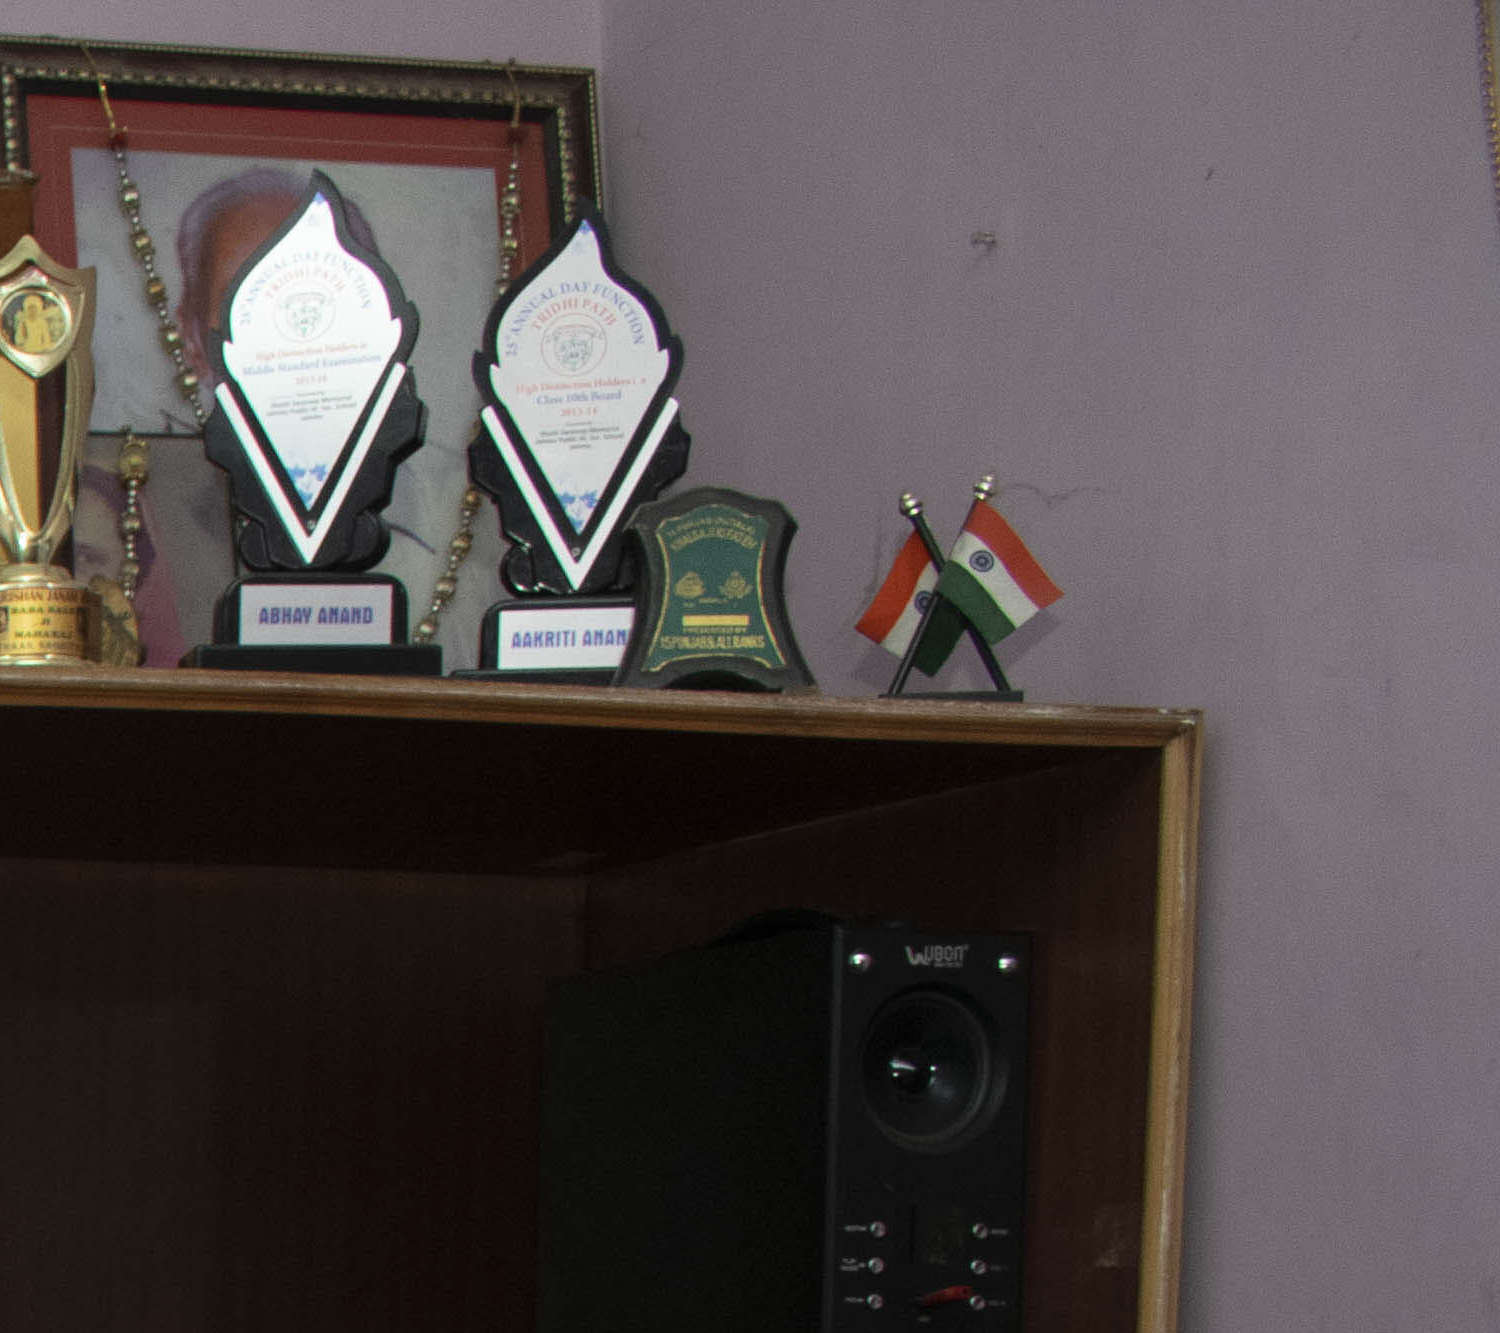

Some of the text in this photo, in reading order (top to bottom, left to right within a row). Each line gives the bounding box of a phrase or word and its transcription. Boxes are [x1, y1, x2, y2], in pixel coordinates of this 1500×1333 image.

[510, 287, 556, 336] ANNUAL
[560, 281, 590, 295] DAY
[593, 283, 645, 345] FUNCTION
[258, 605, 375, 625] ABHAY ANAND
[510, 627, 627, 649] AAKRITI ANAN
